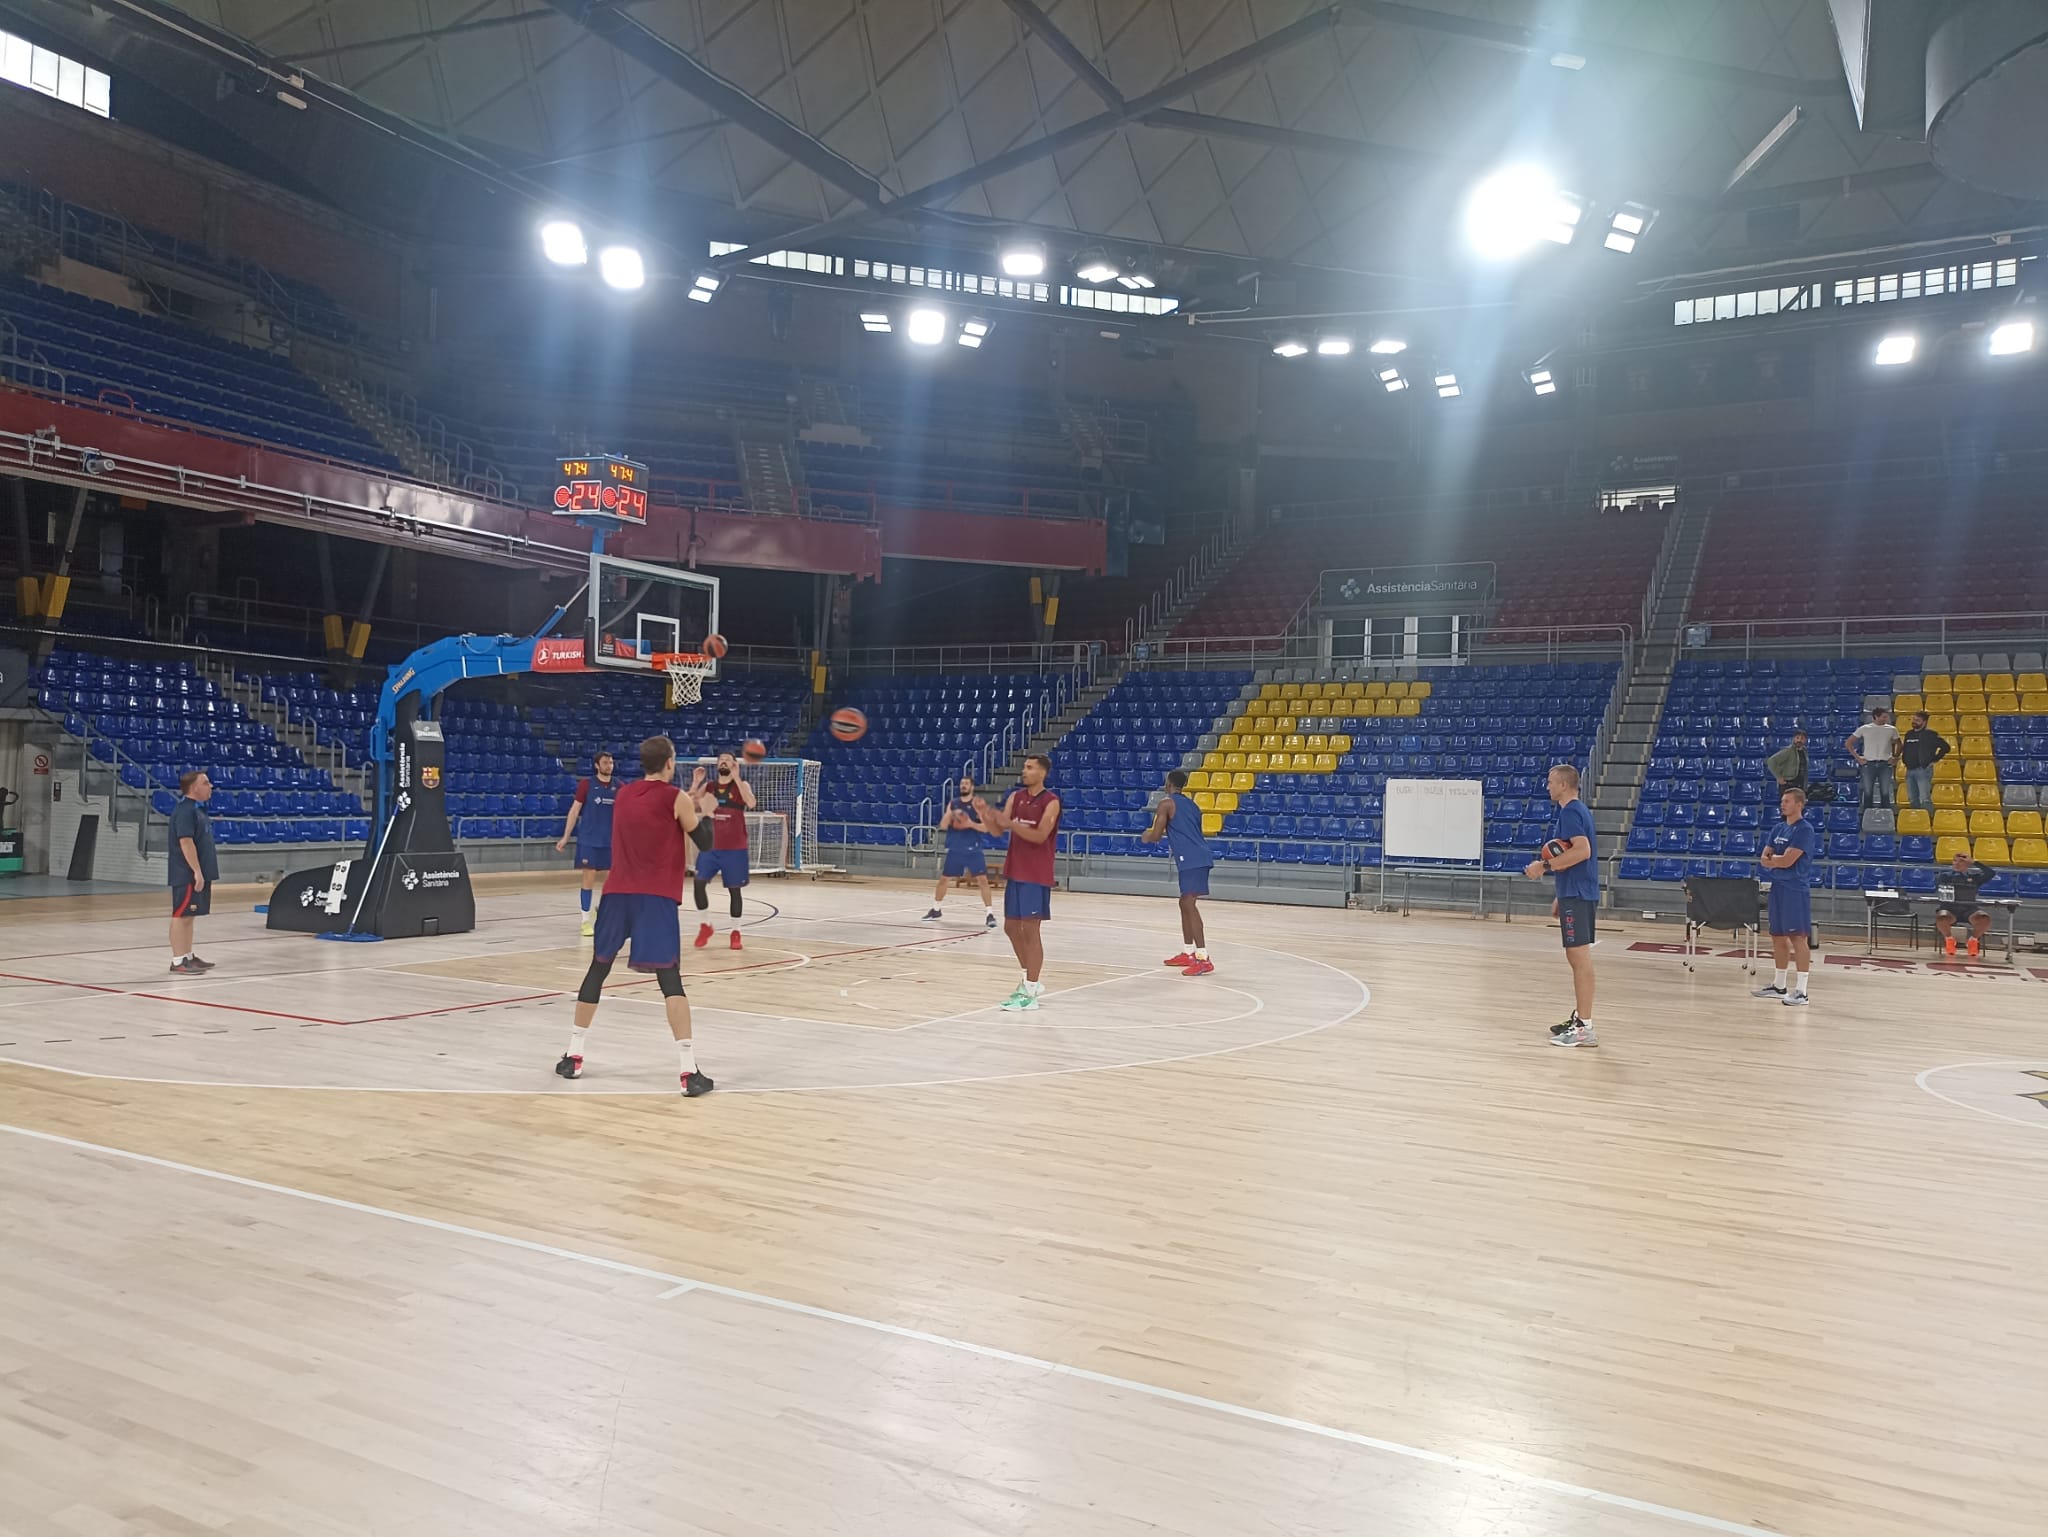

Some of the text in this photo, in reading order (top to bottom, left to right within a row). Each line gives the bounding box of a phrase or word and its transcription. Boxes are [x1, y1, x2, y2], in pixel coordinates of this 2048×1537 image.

[572, 484, 600, 509] 24
[619, 489, 645, 517] 24
[551, 650, 581, 660] TURKISH
